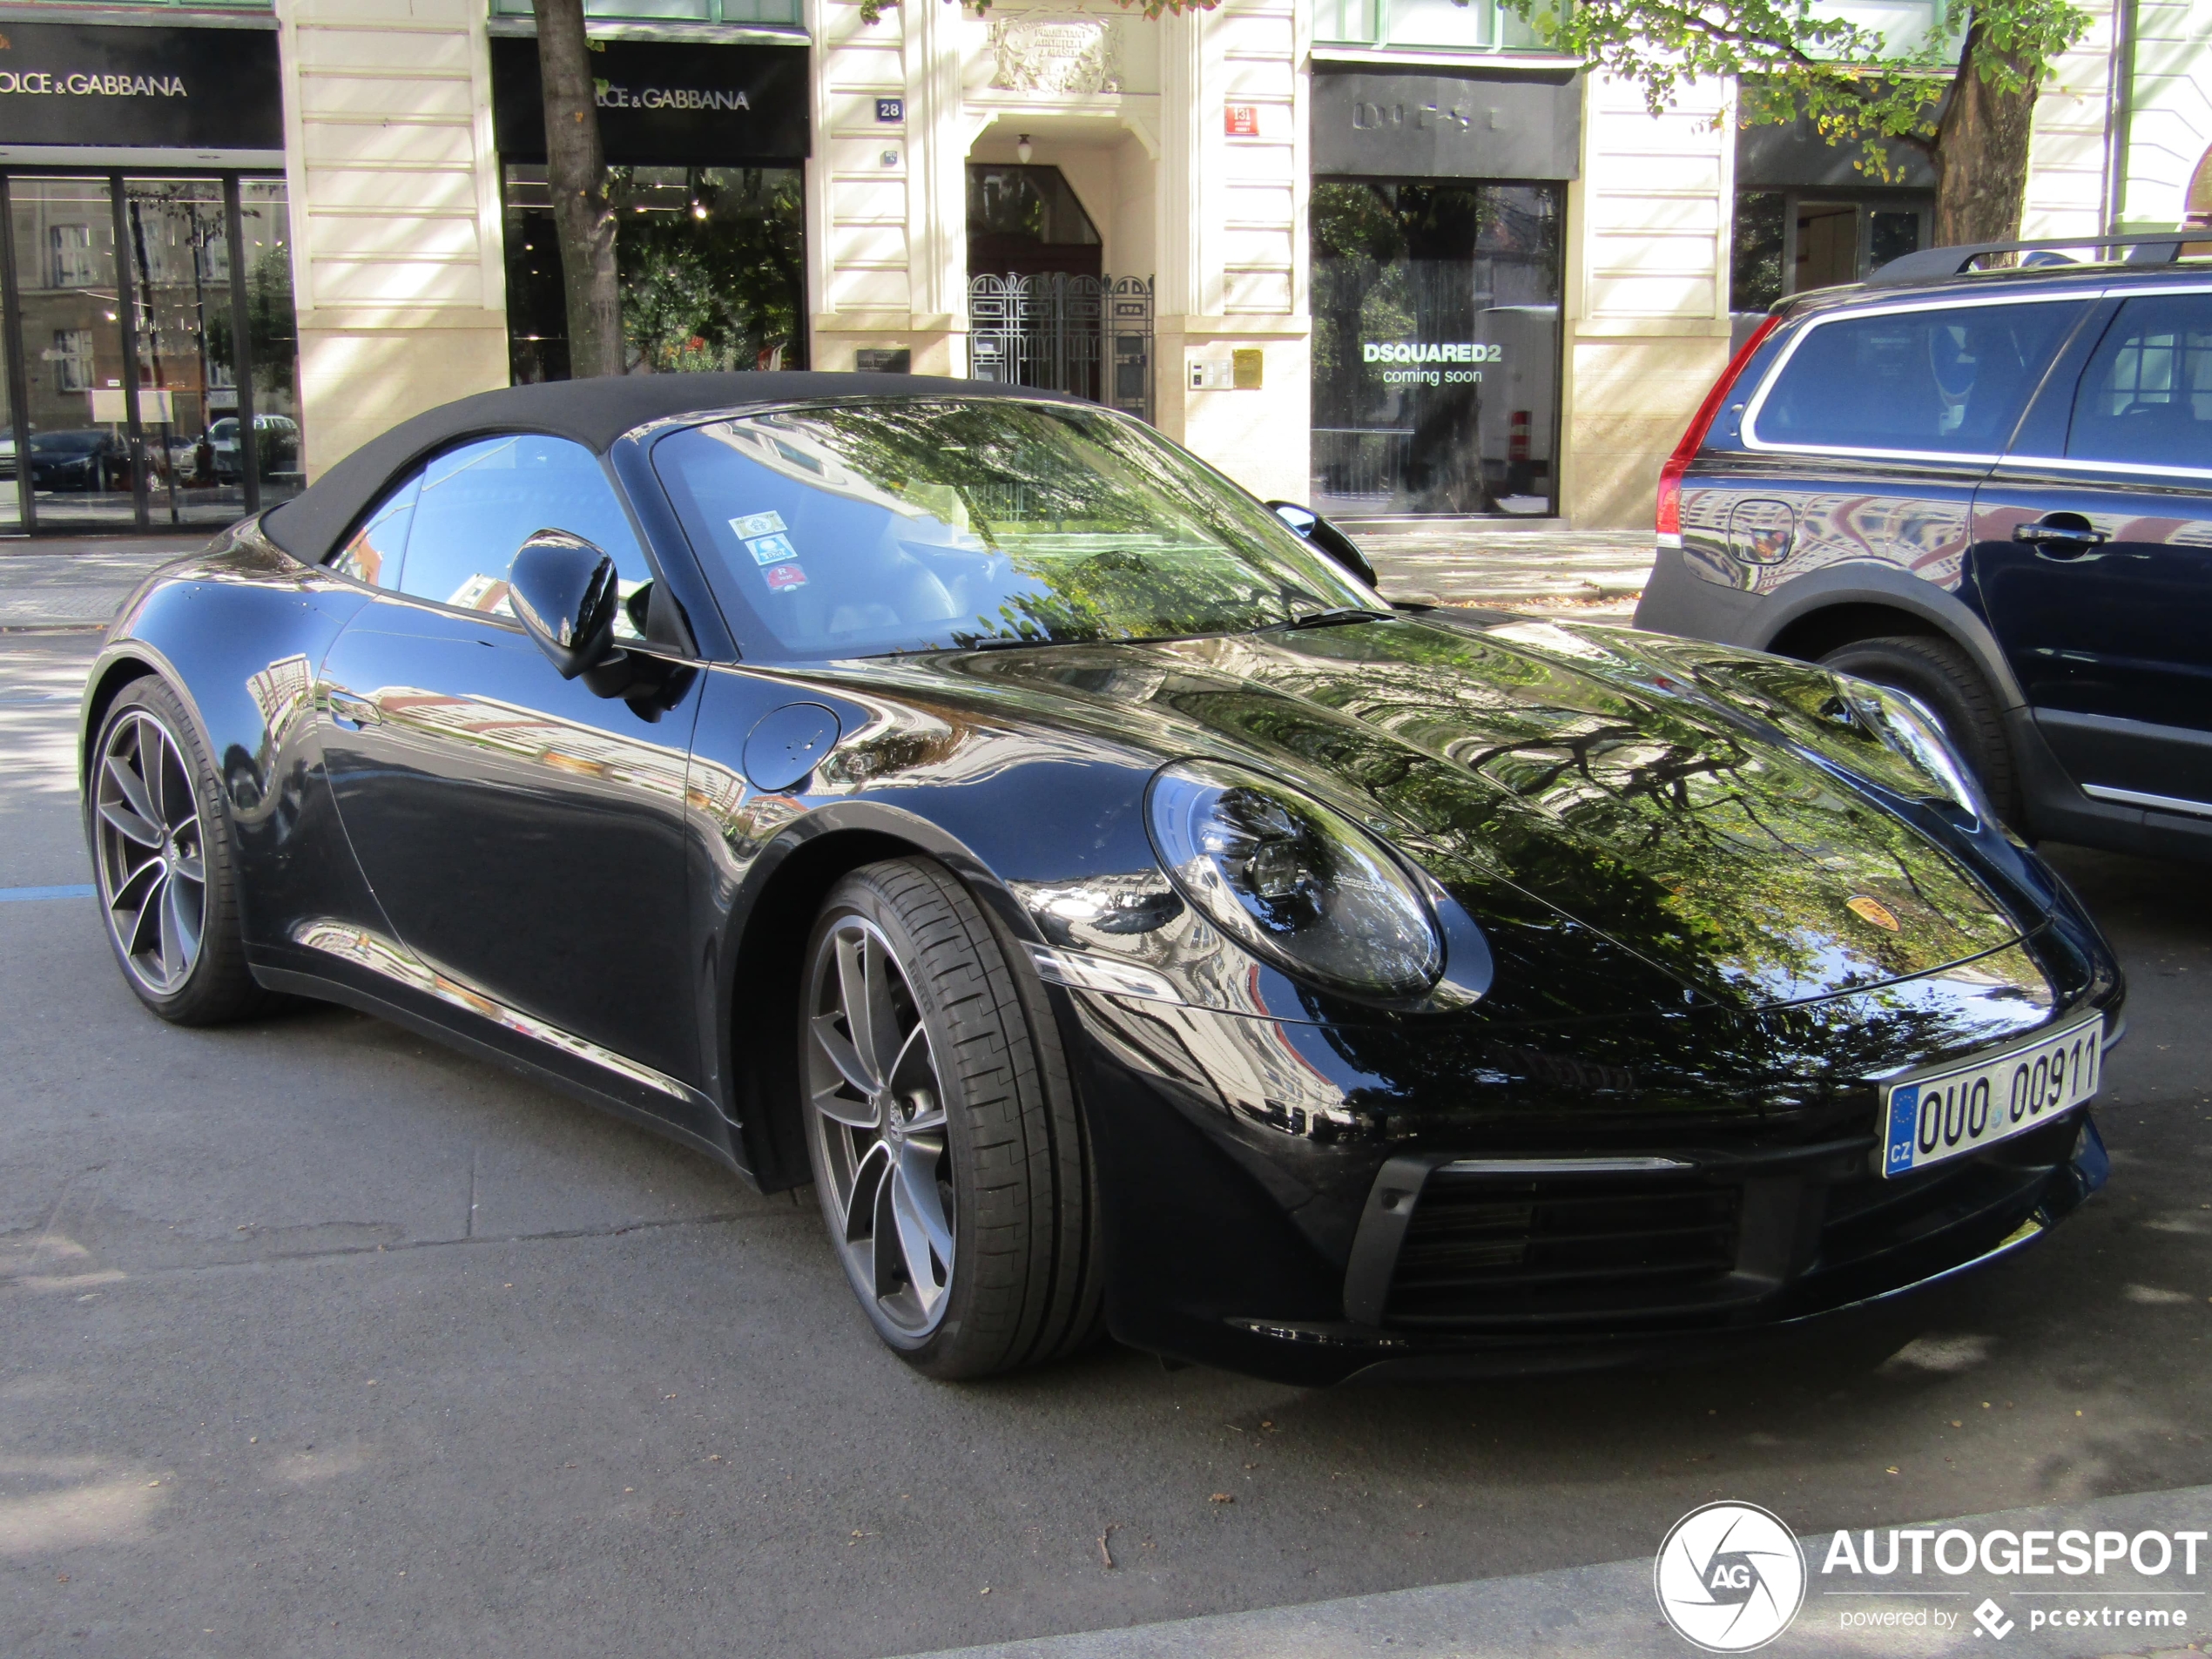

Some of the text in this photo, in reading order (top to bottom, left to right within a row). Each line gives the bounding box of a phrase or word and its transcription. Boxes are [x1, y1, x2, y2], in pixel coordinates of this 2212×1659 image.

[0, 72, 188, 97] OLCE & GABBANA
[631, 96, 642, 108] &
[642, 88, 750, 111] GABBANA
[880, 104, 900, 117] 28
[1233, 107, 1251, 120] 131
[1364, 343, 1501, 363] DSQUARED2
[1383, 368, 1482, 387] coming soon
[907, 957, 934, 1016] PIRELLI
[2008, 1030, 2097, 1123] 00911
[1891, 1141, 1912, 1163] CZ
